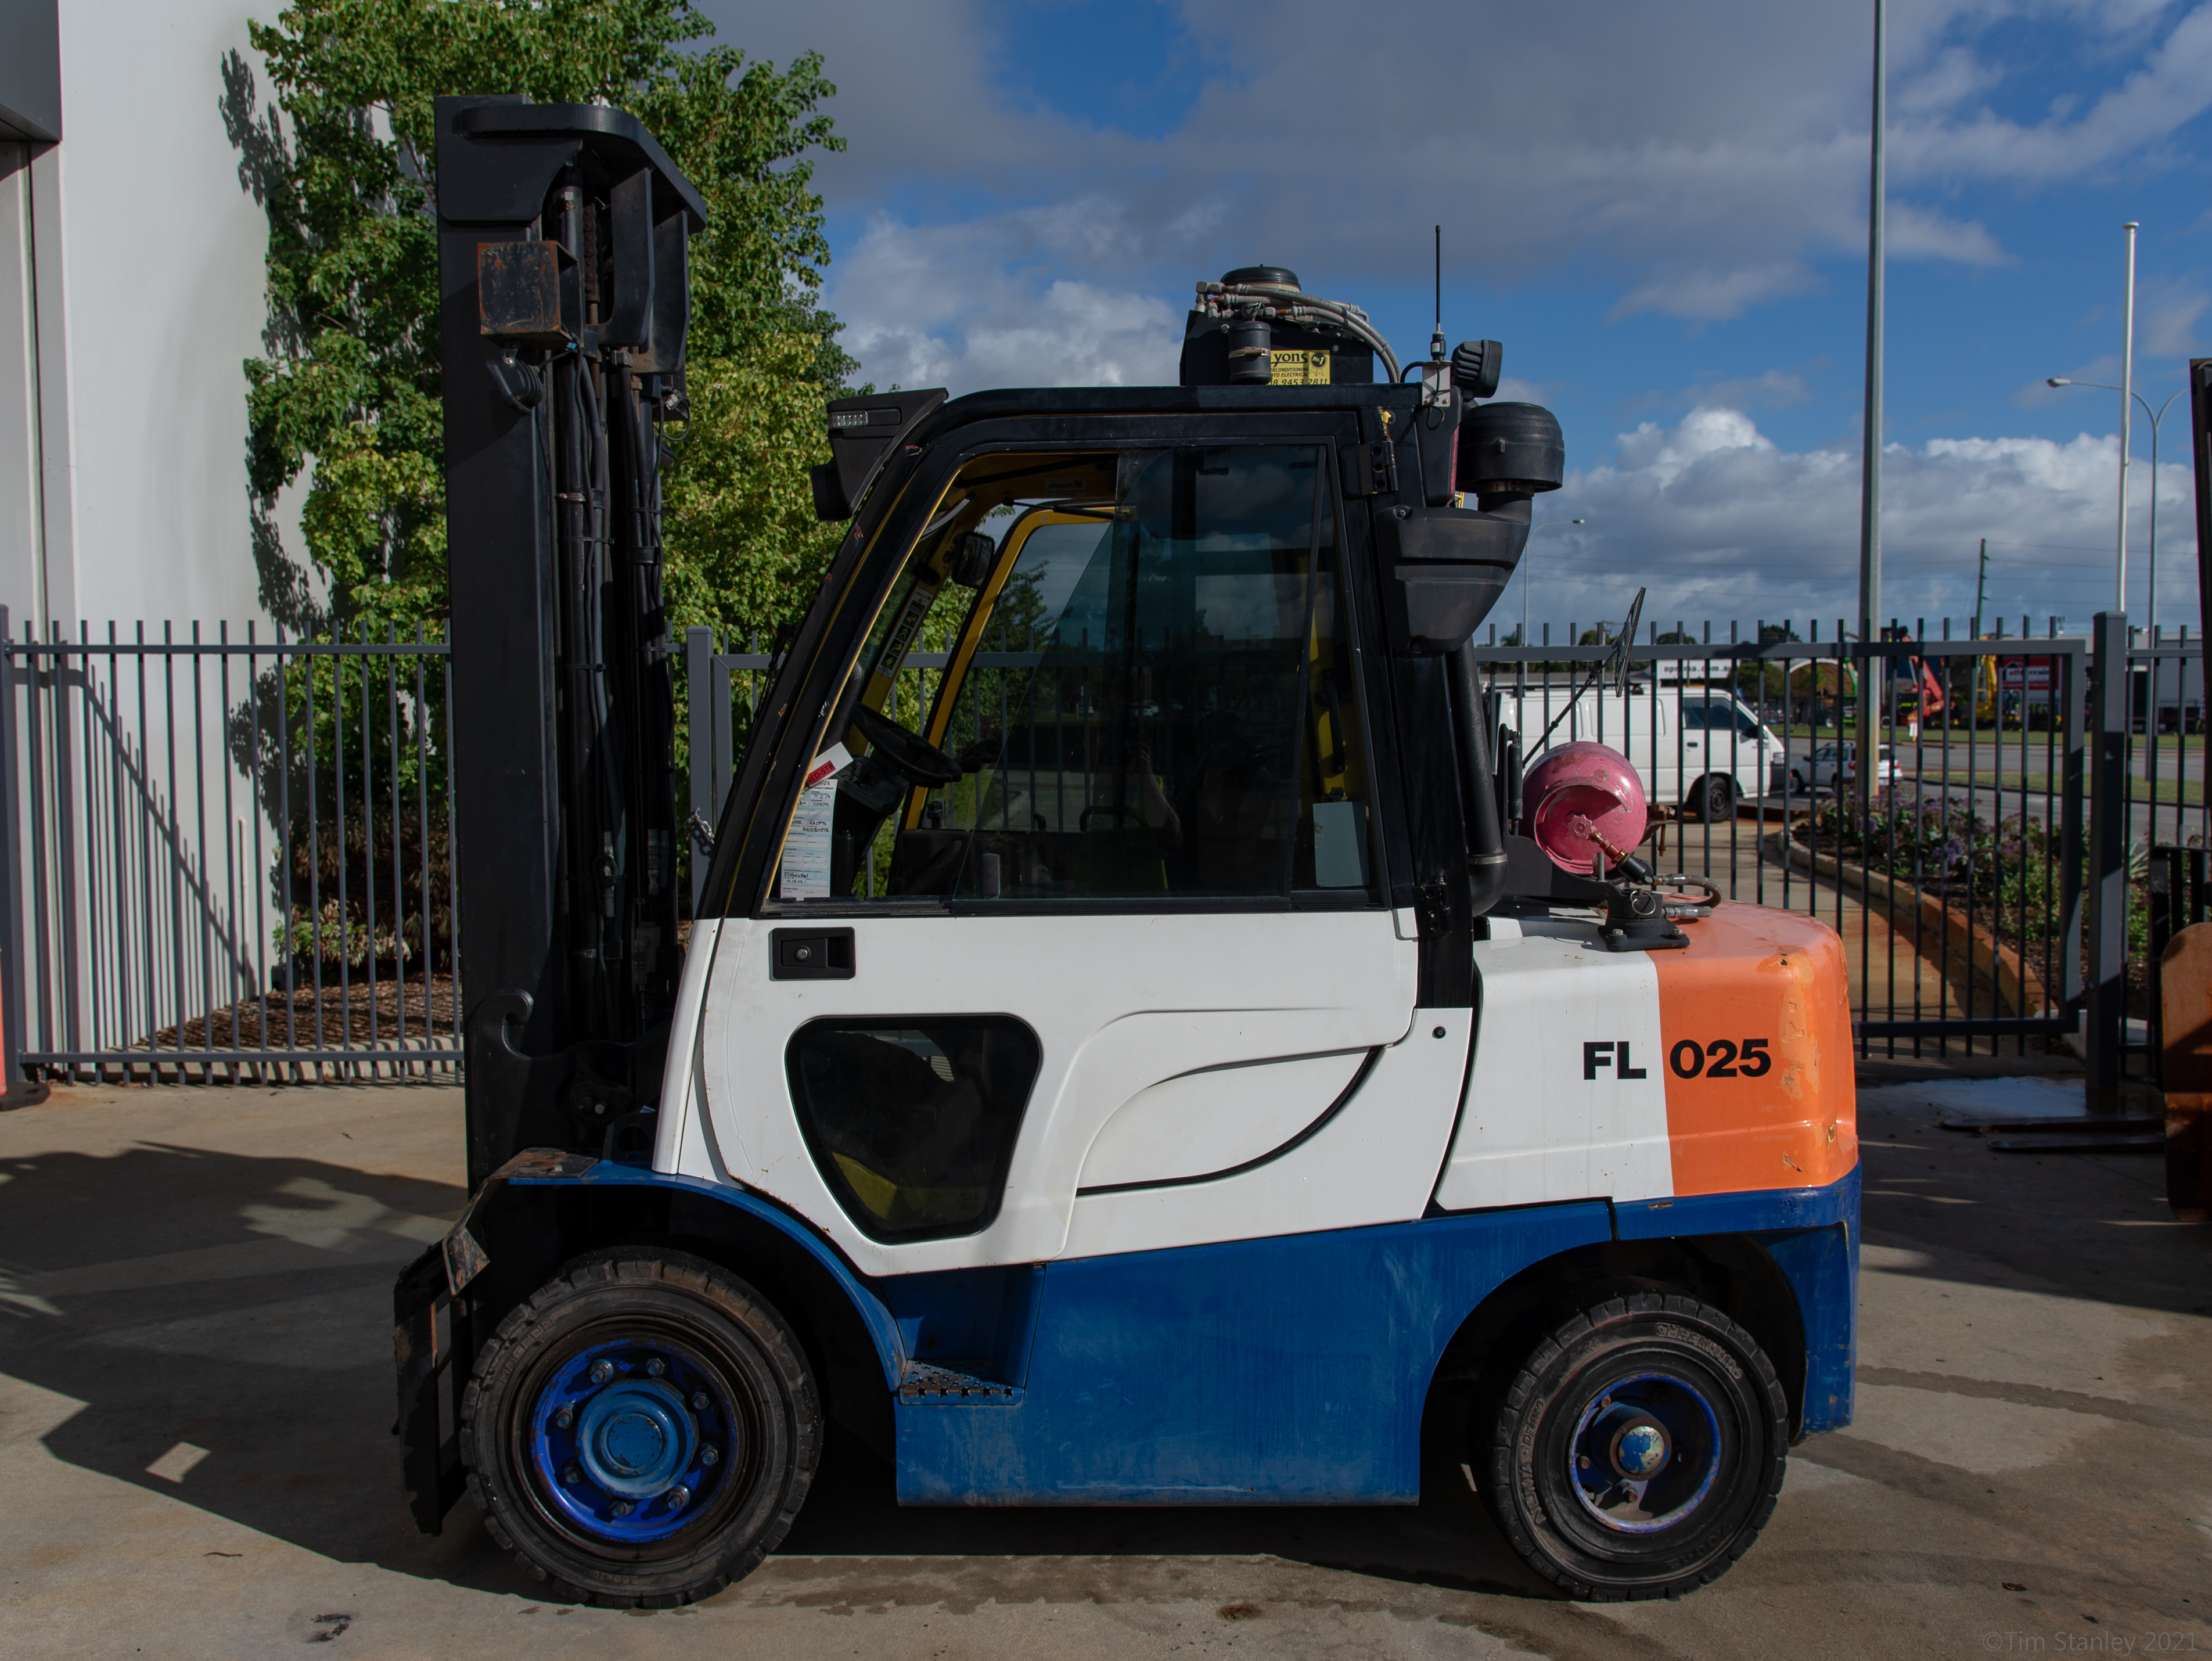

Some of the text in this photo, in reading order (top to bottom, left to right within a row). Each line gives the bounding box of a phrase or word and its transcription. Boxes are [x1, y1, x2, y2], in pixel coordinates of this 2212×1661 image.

[1271, 353, 1308, 368] yons
[1312, 356, 1325, 365] No.1
[1583, 1038, 1771, 1080] FL 025
